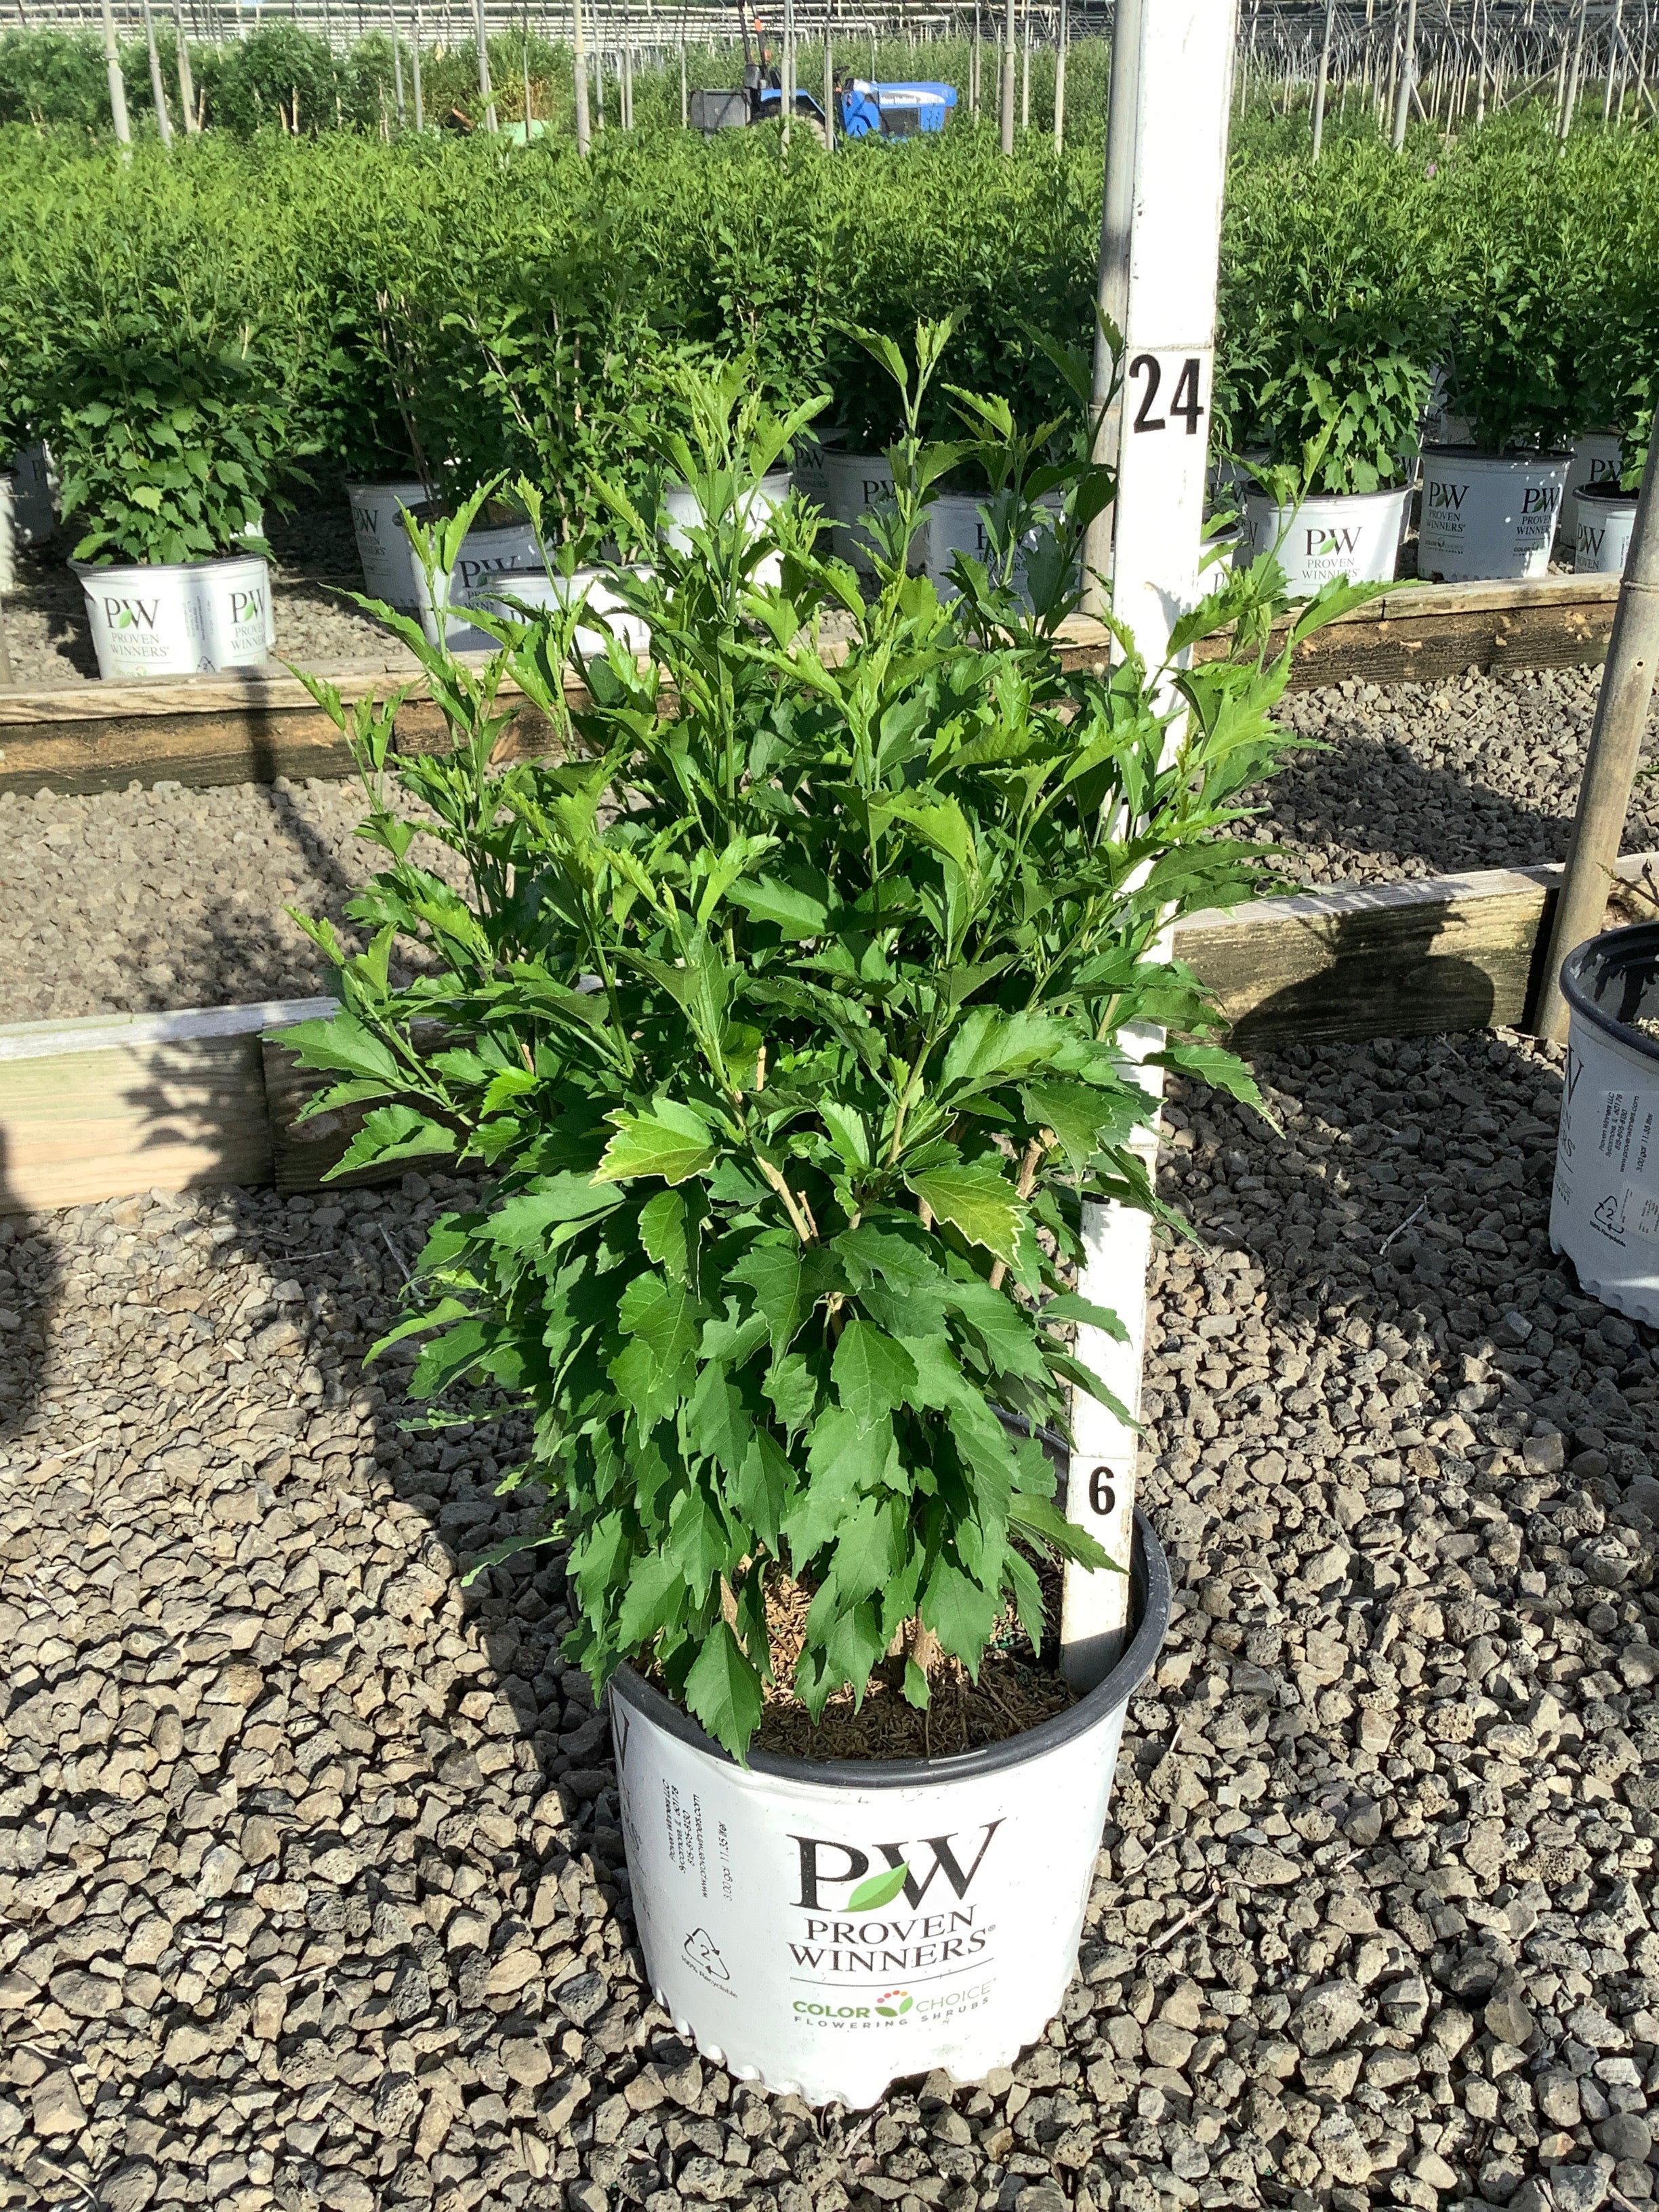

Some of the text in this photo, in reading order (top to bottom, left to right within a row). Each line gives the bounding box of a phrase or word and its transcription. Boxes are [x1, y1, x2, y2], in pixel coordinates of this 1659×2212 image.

[1129, 354, 1204, 435] 24
[1428, 481, 1470, 510] PW
[1521, 487, 1560, 514] PW
[1429, 509, 1461, 522] PROVEN
[1303, 526, 1364, 556] PW
[1307, 557, 1355, 569] PROVEN
[102, 596, 161, 630] PW
[111, 632, 160, 644] PROVEN
[1607, 1092, 1615, 1105] LLC
[1089, 1466, 1115, 1515] 6
[665, 1797, 673, 1831] Winners
[672, 1784, 680, 1816] 60178
[682, 1809, 695, 1867] 815-895-8130
[693, 1794, 708, 1898] www.provenwinners.com
[718, 1821, 733, 1902] 3.00 gal 11.35 liter
[785, 1816, 1007, 1911] PW
[804, 1904, 977, 1944] PROVEN
[699, 1970, 738, 1999] Recyclable
[793, 1980, 991, 2018] COLOR CHOICE
[794, 1996, 989, 2029] FLOWERING SHRUBS
